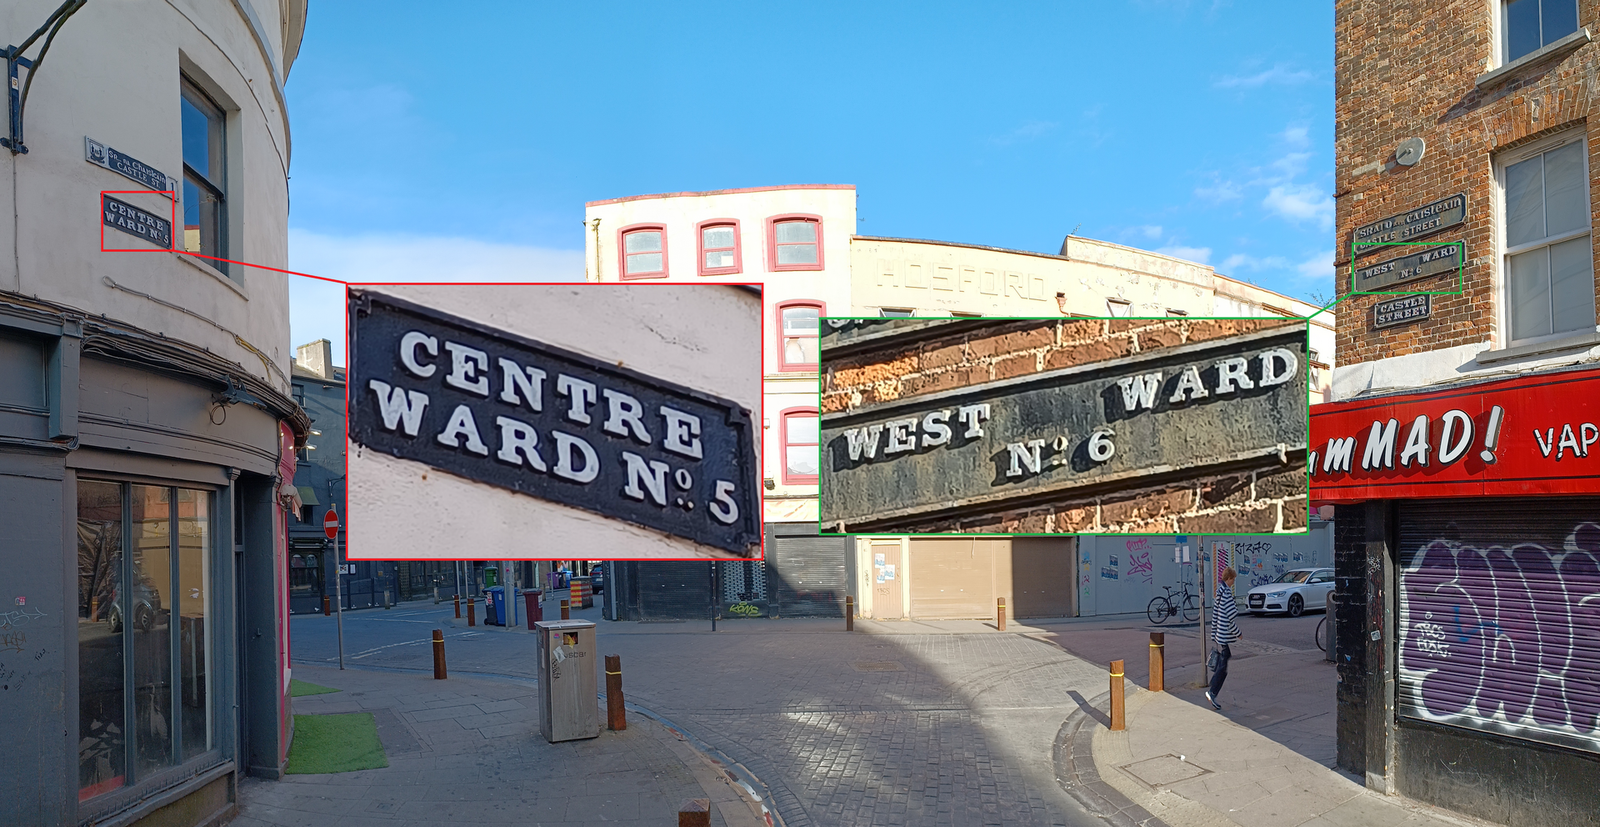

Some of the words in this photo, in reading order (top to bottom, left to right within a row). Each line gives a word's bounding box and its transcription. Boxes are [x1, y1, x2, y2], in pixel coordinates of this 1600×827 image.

[116, 162, 147, 182] CASTLE
[104, 210, 146, 234] WARD
[163, 234, 169, 244] 5
[109, 201, 163, 231] CENTRE
[1360, 230, 1397, 249] CASTLE
[1403, 217, 1442, 237] STREET
[1365, 262, 1395, 278] WEST
[1421, 245, 1457, 262] WARD
[1415, 265, 1422, 274] 6
[877, 258, 1048, 302] HOSFORD
[1378, 305, 1427, 323] STREET
[1380, 295, 1426, 313] CASTLE
[400, 331, 704, 460] CENTRE
[1116, 347, 1300, 412] WARD
[844, 403, 992, 461] WEST
[1087, 428, 1117, 463] 6
[1361, 405, 1504, 472] MAD!
[369, 379, 600, 484] WARD
[709, 480, 740, 524] 5
